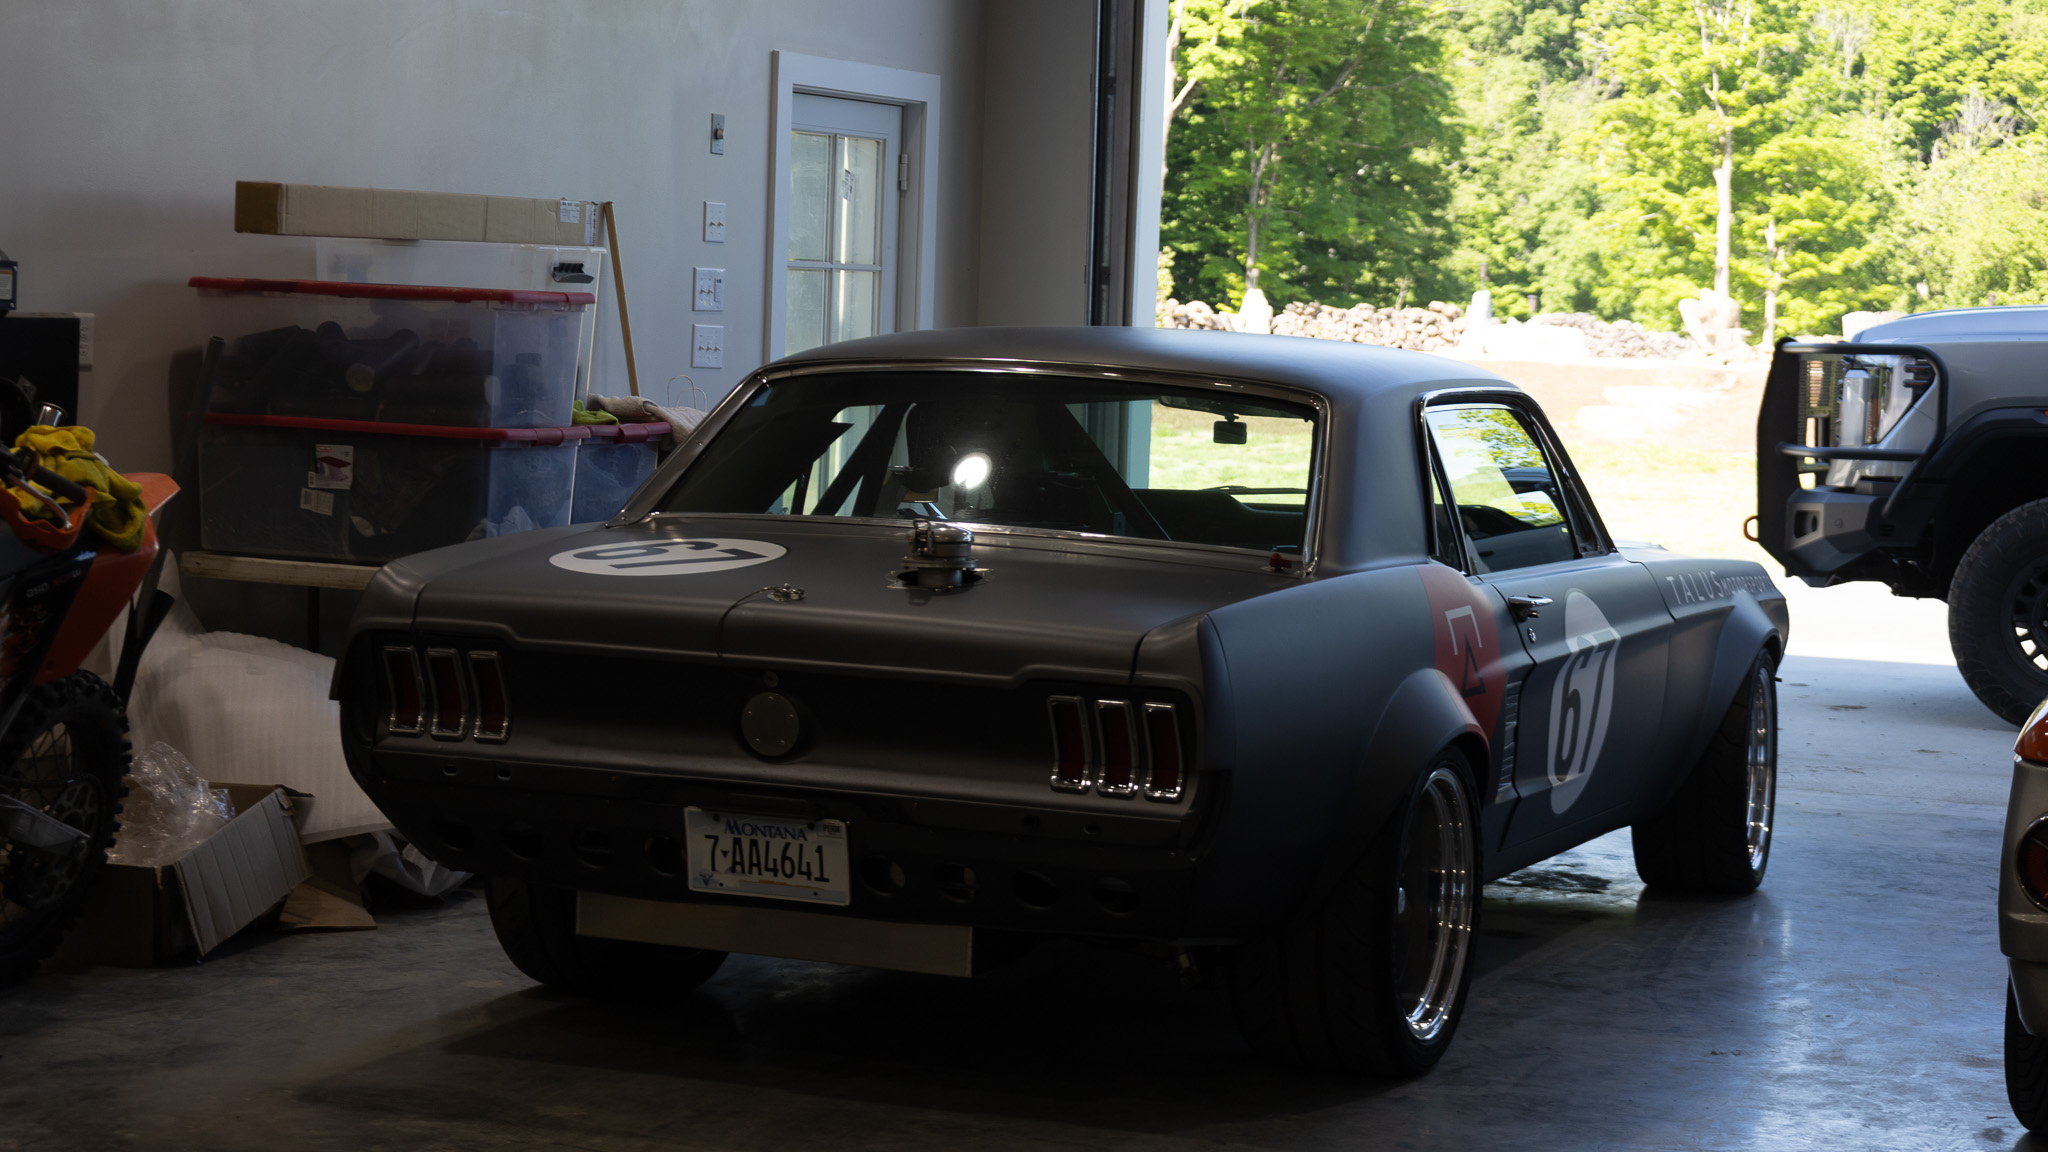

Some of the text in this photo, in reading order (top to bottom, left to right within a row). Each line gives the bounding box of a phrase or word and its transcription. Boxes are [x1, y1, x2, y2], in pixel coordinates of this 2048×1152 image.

[1665, 570, 1724, 605] TALUS
[1554, 627, 1617, 783] 67
[725, 818, 808, 841] MONTANA
